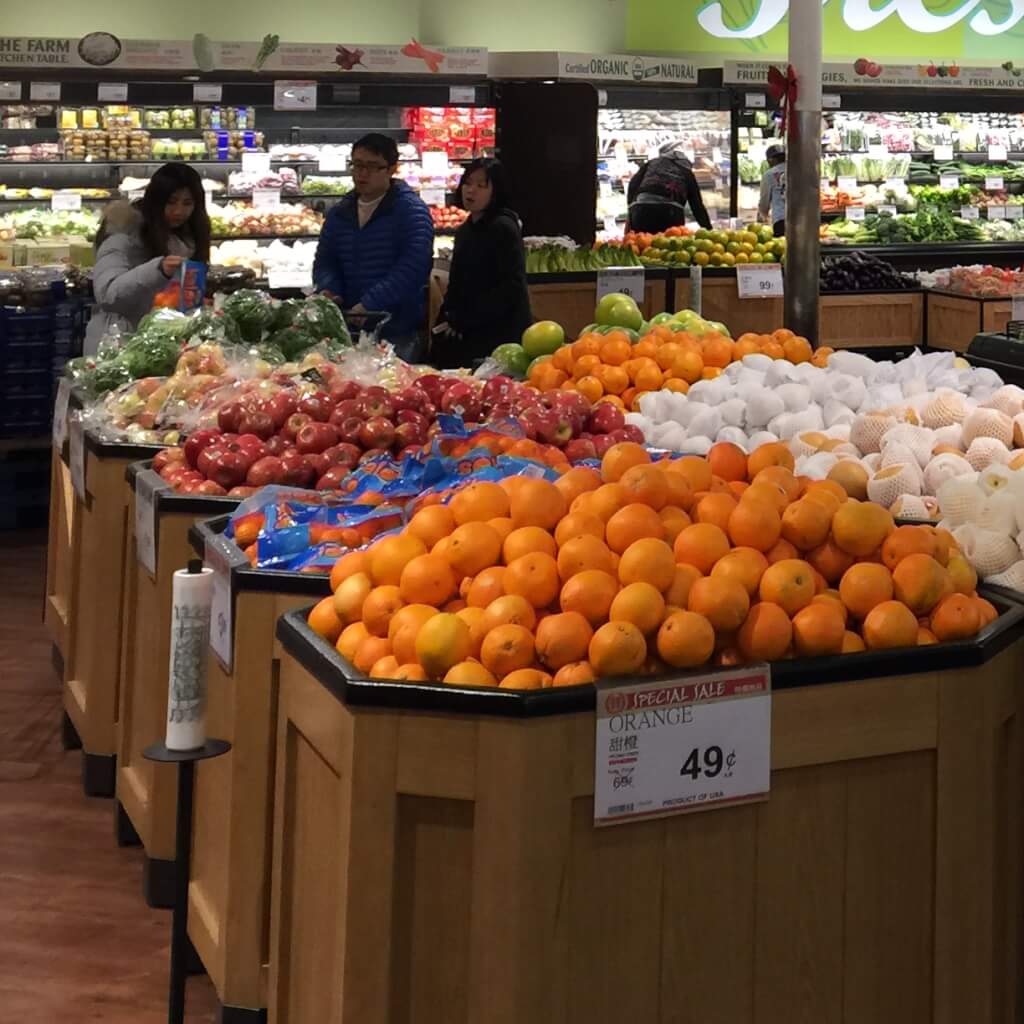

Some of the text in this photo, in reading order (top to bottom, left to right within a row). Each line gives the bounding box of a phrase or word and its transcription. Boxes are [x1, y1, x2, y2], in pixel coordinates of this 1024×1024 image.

[27, 39, 70, 53] FARM
[590, 59, 629, 76] ORGANIC
[660, 63, 695, 79] NATURAL
[968, 79, 995, 87] FRESH
[996, 79, 1014, 87] AND
[633, 690, 689, 707] SPECIAL
[694, 682, 725, 700] SALE
[609, 704, 693, 734] ORANGE
